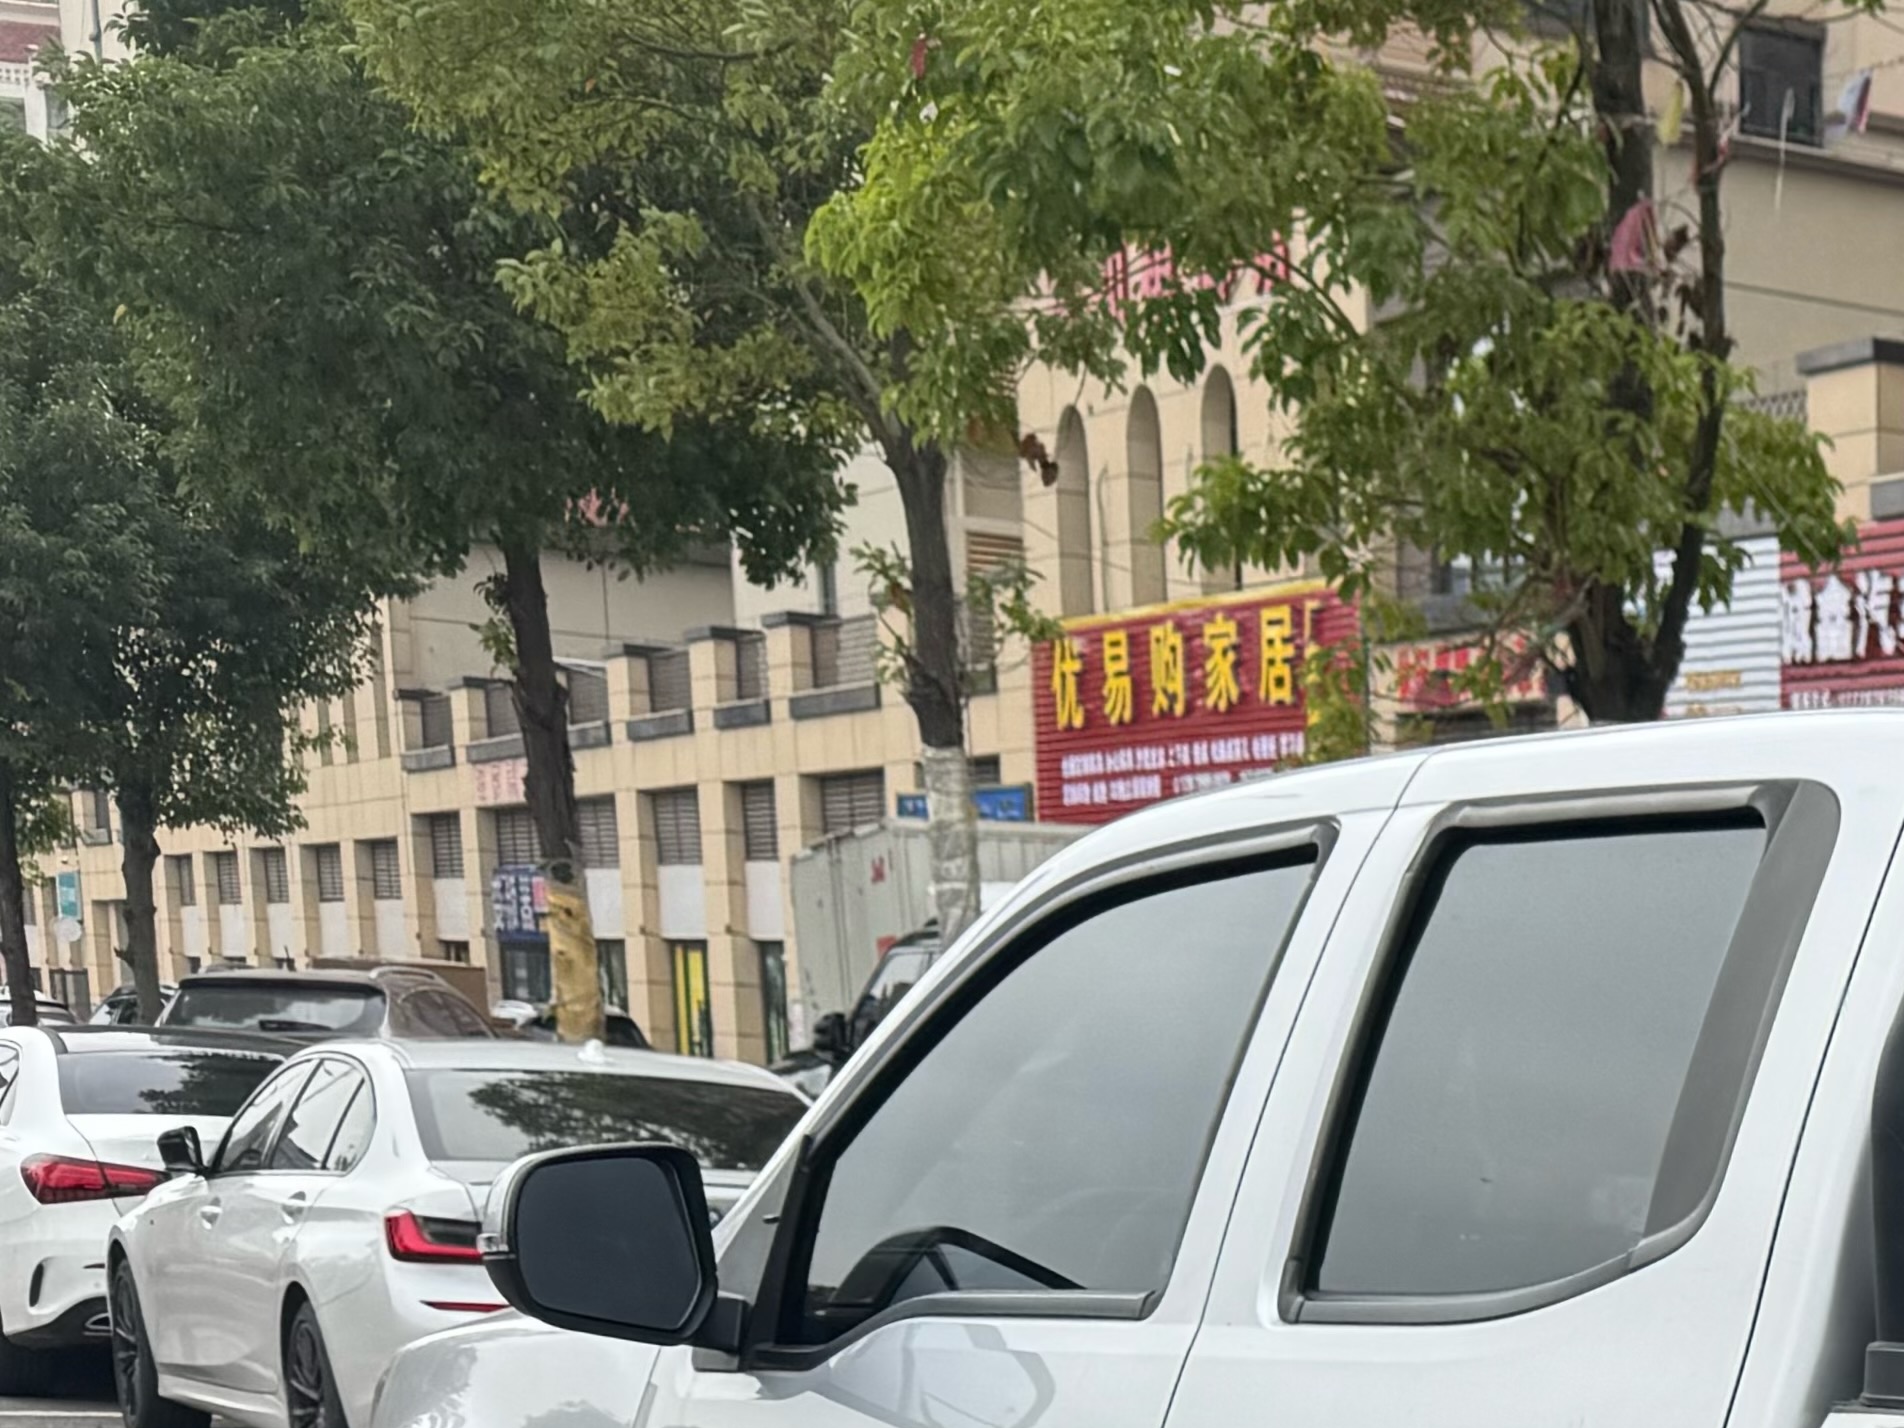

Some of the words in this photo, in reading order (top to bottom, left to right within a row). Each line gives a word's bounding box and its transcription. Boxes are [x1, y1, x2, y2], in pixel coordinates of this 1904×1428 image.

[1051, 598, 1322, 731] 优易购家居
